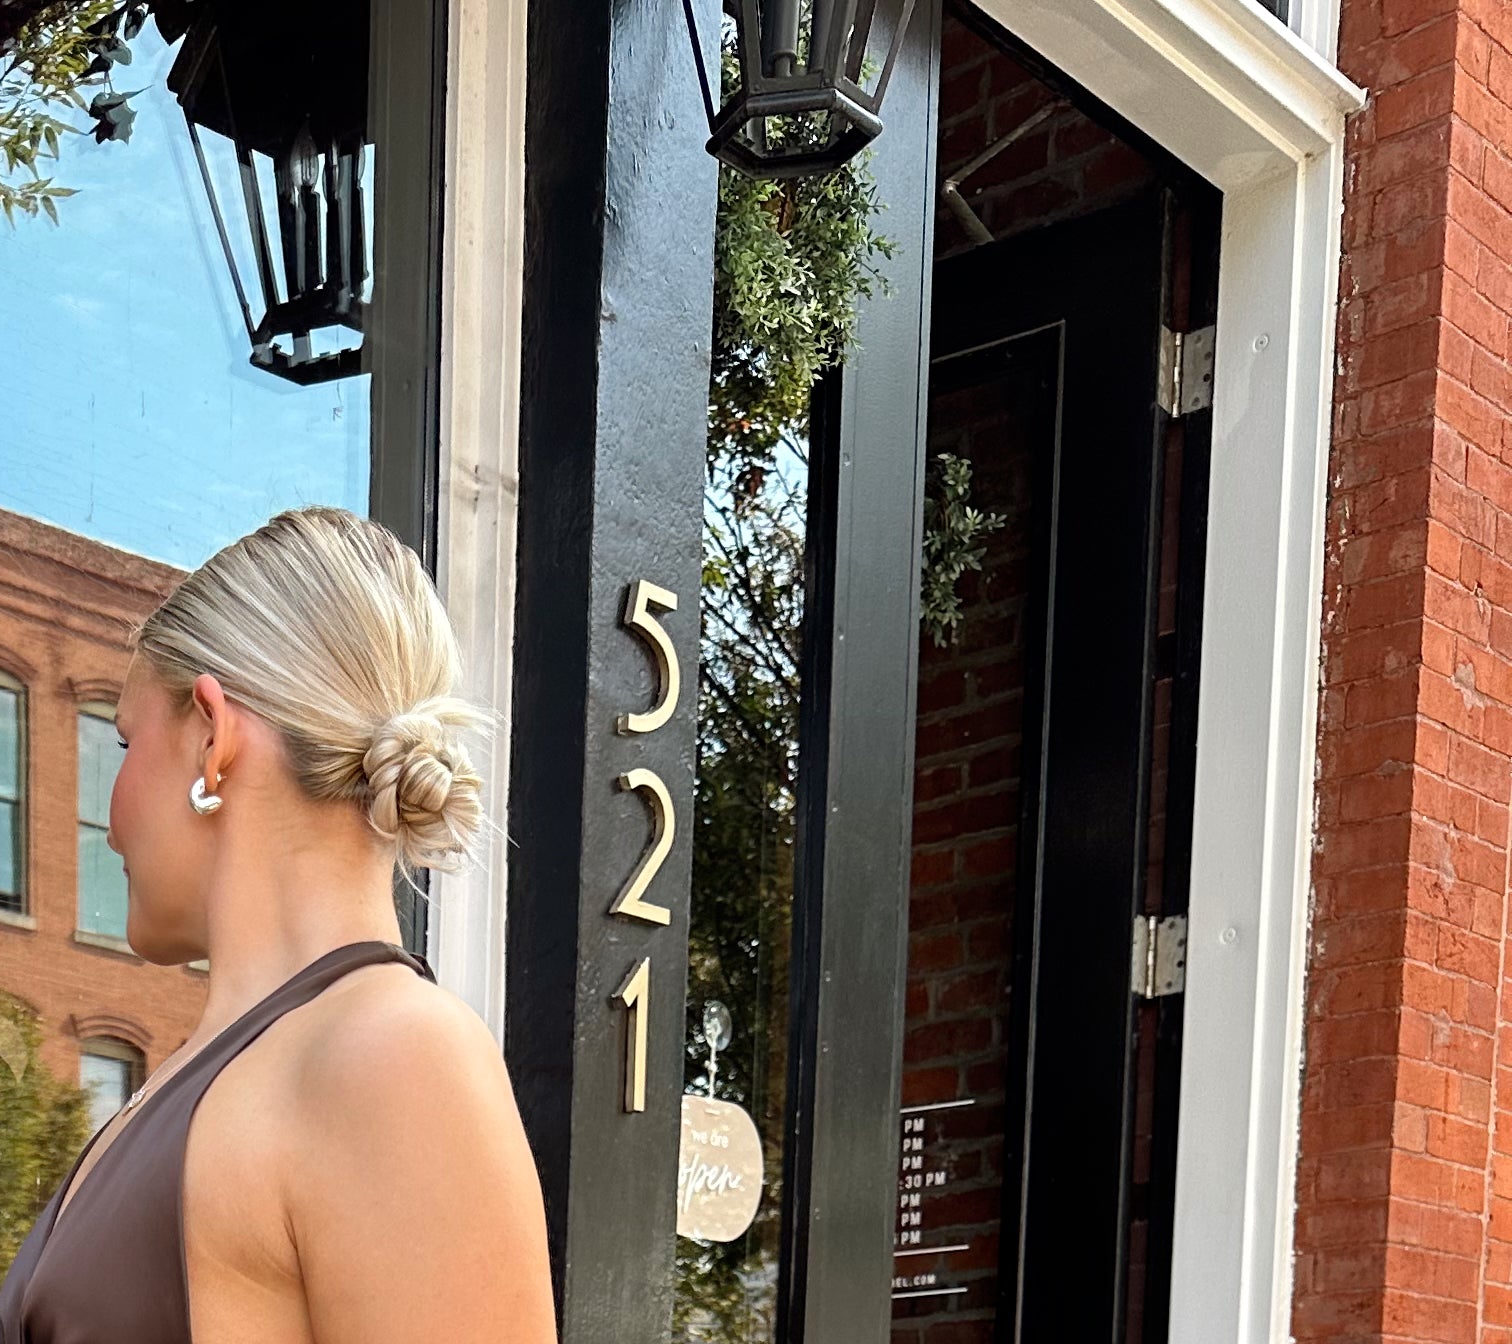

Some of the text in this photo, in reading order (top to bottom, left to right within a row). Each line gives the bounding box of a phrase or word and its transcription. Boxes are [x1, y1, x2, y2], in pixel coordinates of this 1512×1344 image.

[609, 579, 681, 1113] 521
[904, 1118, 925, 1133] PM
[691, 1130, 729, 1148] we are
[903, 1137, 923, 1152] PM
[902, 1155, 922, 1170] PM
[925, 1171, 946, 1187] PM
[901, 1192, 920, 1208] PM
[901, 1211, 920, 1227] PM
[901, 1231, 920, 1245] PM
